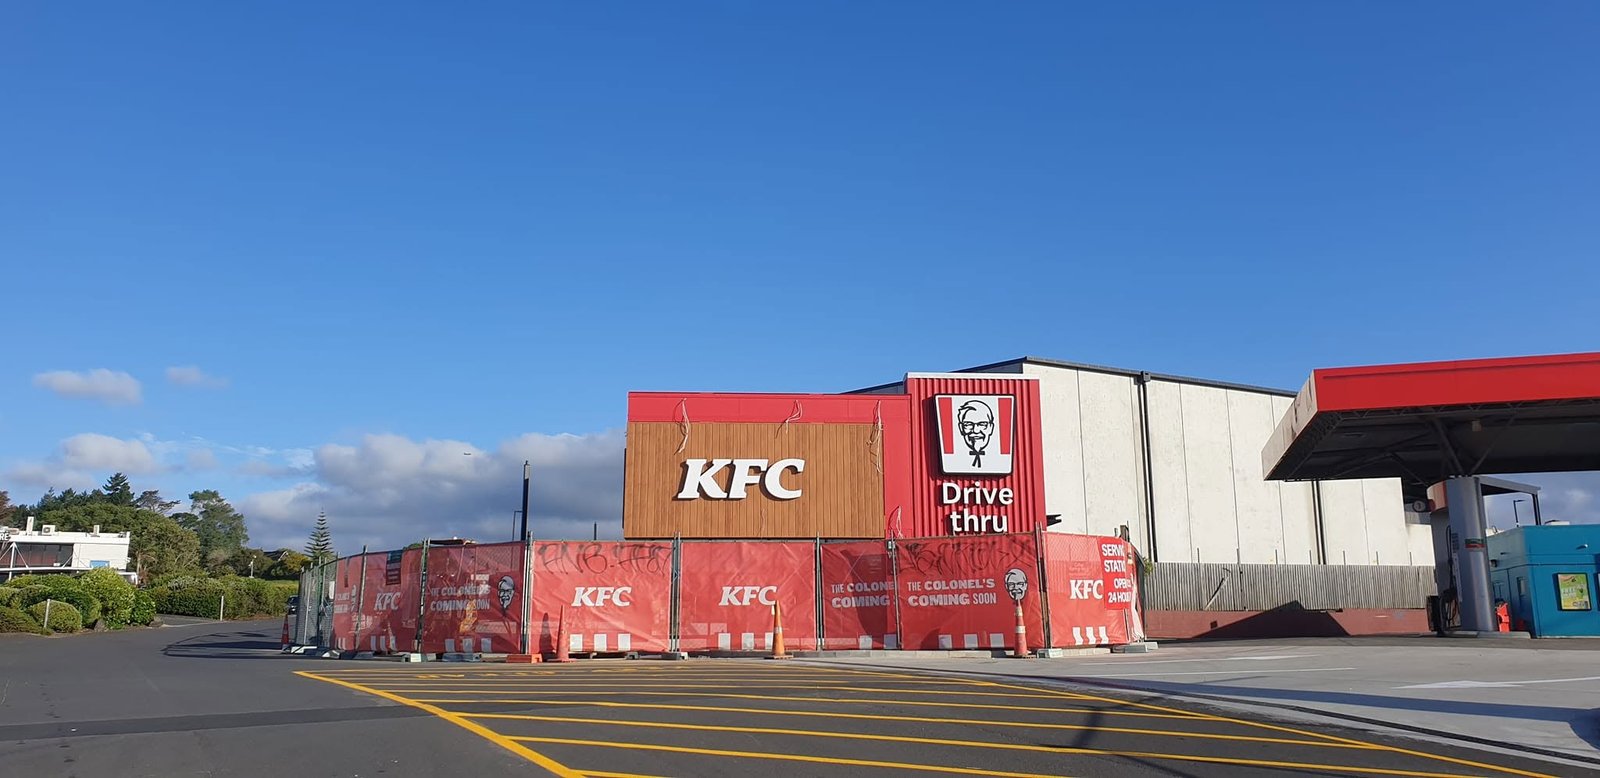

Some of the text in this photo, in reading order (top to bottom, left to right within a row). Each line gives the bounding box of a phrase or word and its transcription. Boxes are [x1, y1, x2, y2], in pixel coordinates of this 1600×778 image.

[677, 458, 806, 499] KFC
[942, 481, 1014, 505] Drive
[950, 507, 1008, 533] thru
[831, 583, 845, 594] THE
[908, 578, 996, 591] THE COLONEL'S
[1069, 579, 1104, 600] KFC
[374, 591, 401, 611] KFC
[571, 586, 632, 607] KFC
[718, 585, 777, 606] KFC
[831, 595, 891, 609] COMING
[908, 594, 970, 607] COMING
[973, 592, 997, 604] SOON
